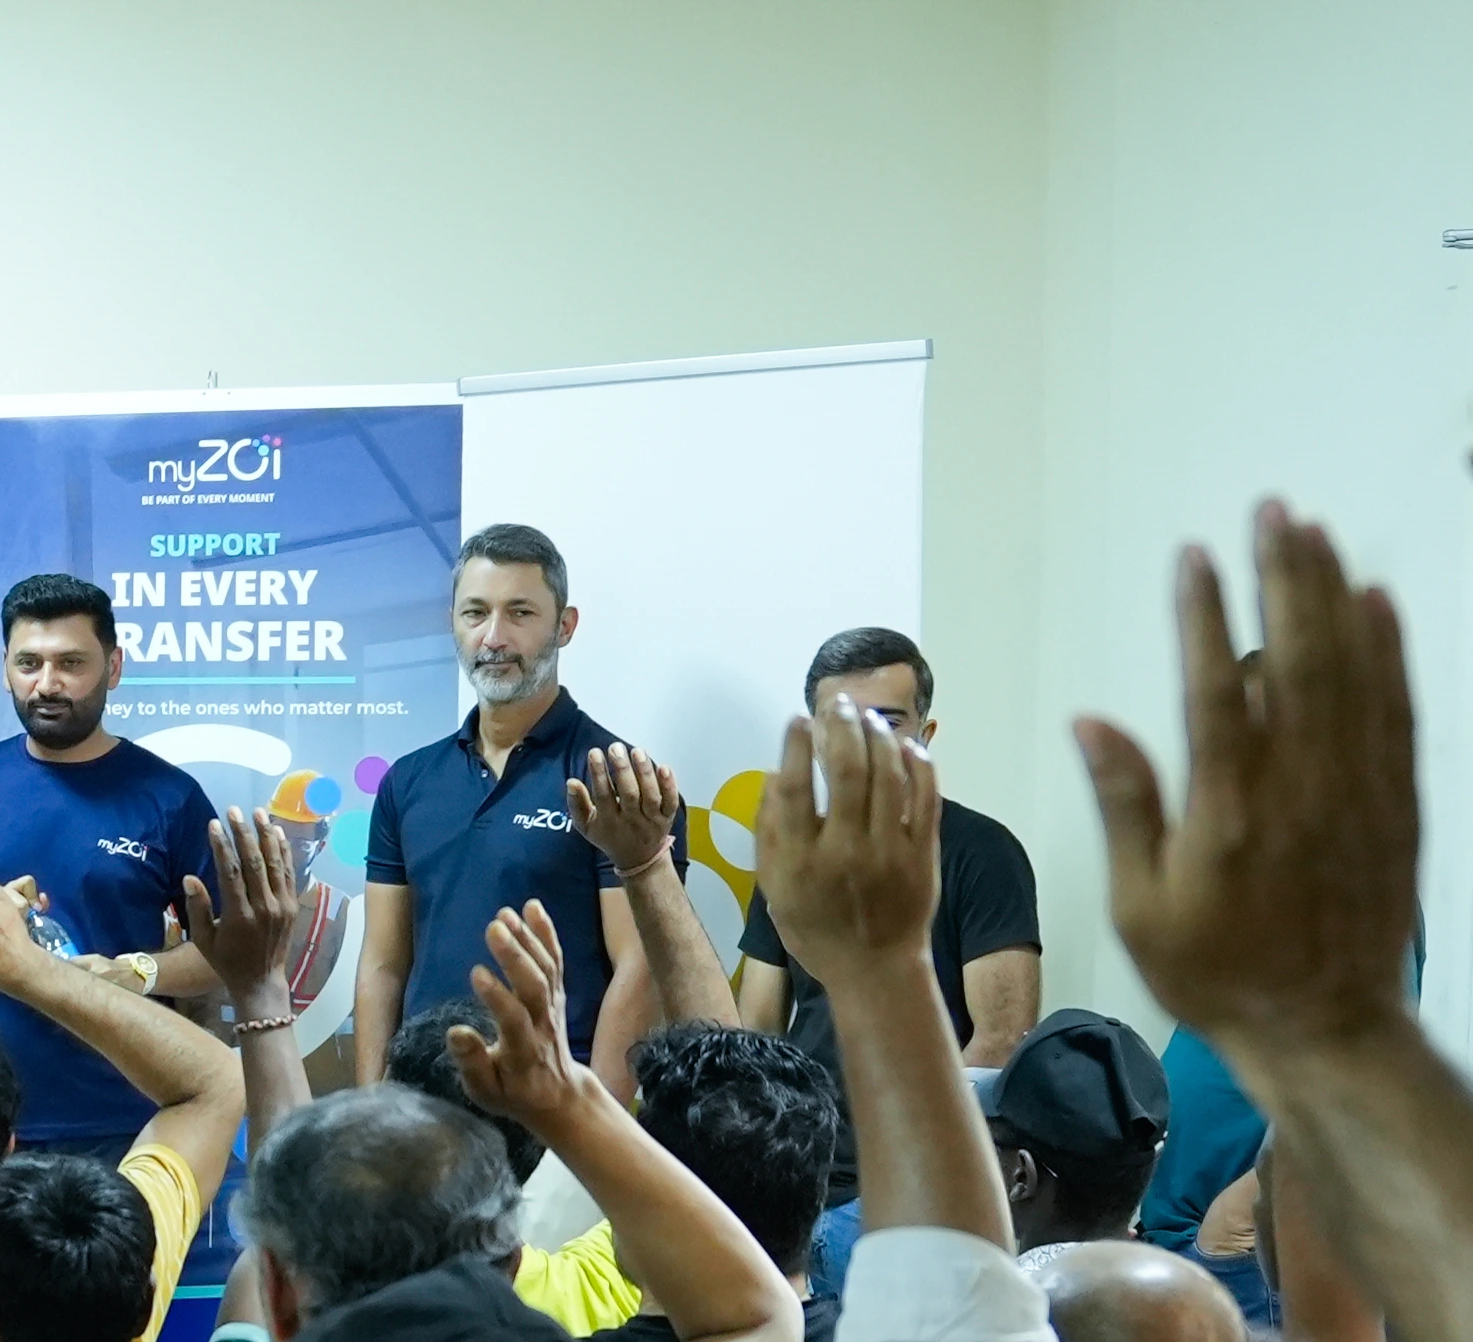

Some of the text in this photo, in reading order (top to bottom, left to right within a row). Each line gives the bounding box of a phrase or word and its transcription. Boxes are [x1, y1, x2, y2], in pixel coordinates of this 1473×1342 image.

[141, 492, 276, 506] BE PART OF EVERY MOMENT
[150, 532, 281, 558] SUPPORT
[111, 569, 318, 608] IN EVERY
[115, 620, 347, 663] RANSFER
[105, 700, 409, 719] ney to the ones who matter most.
